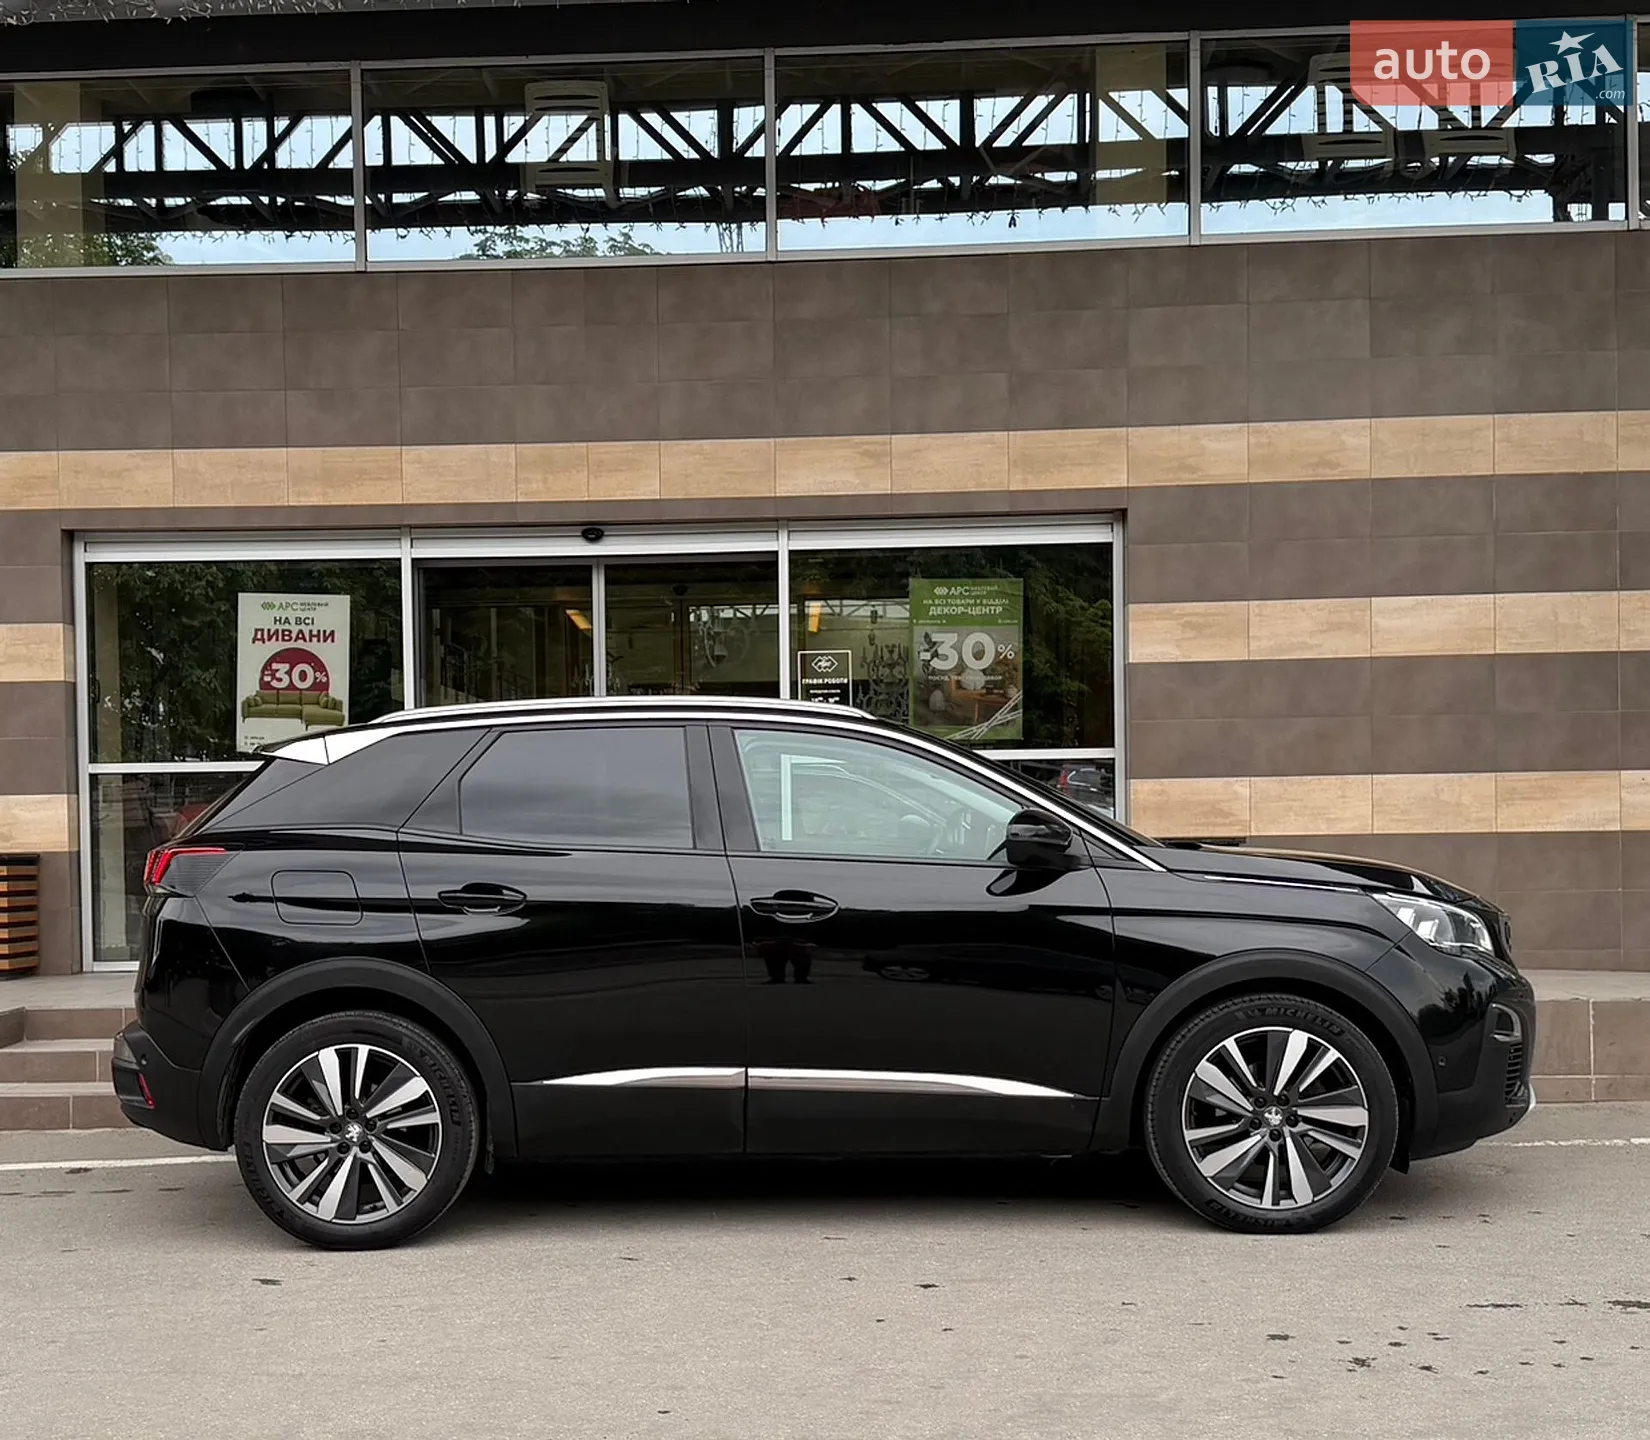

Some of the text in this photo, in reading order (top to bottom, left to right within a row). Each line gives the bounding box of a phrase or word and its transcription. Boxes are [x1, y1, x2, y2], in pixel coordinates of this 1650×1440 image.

[277, 601, 300, 612] АРС
[928, 605, 1003, 616] ДЕКОР-ЦЕНТР
[273, 616, 315, 626] НА ВСІ
[252, 628, 336, 644] ДИВАНИ
